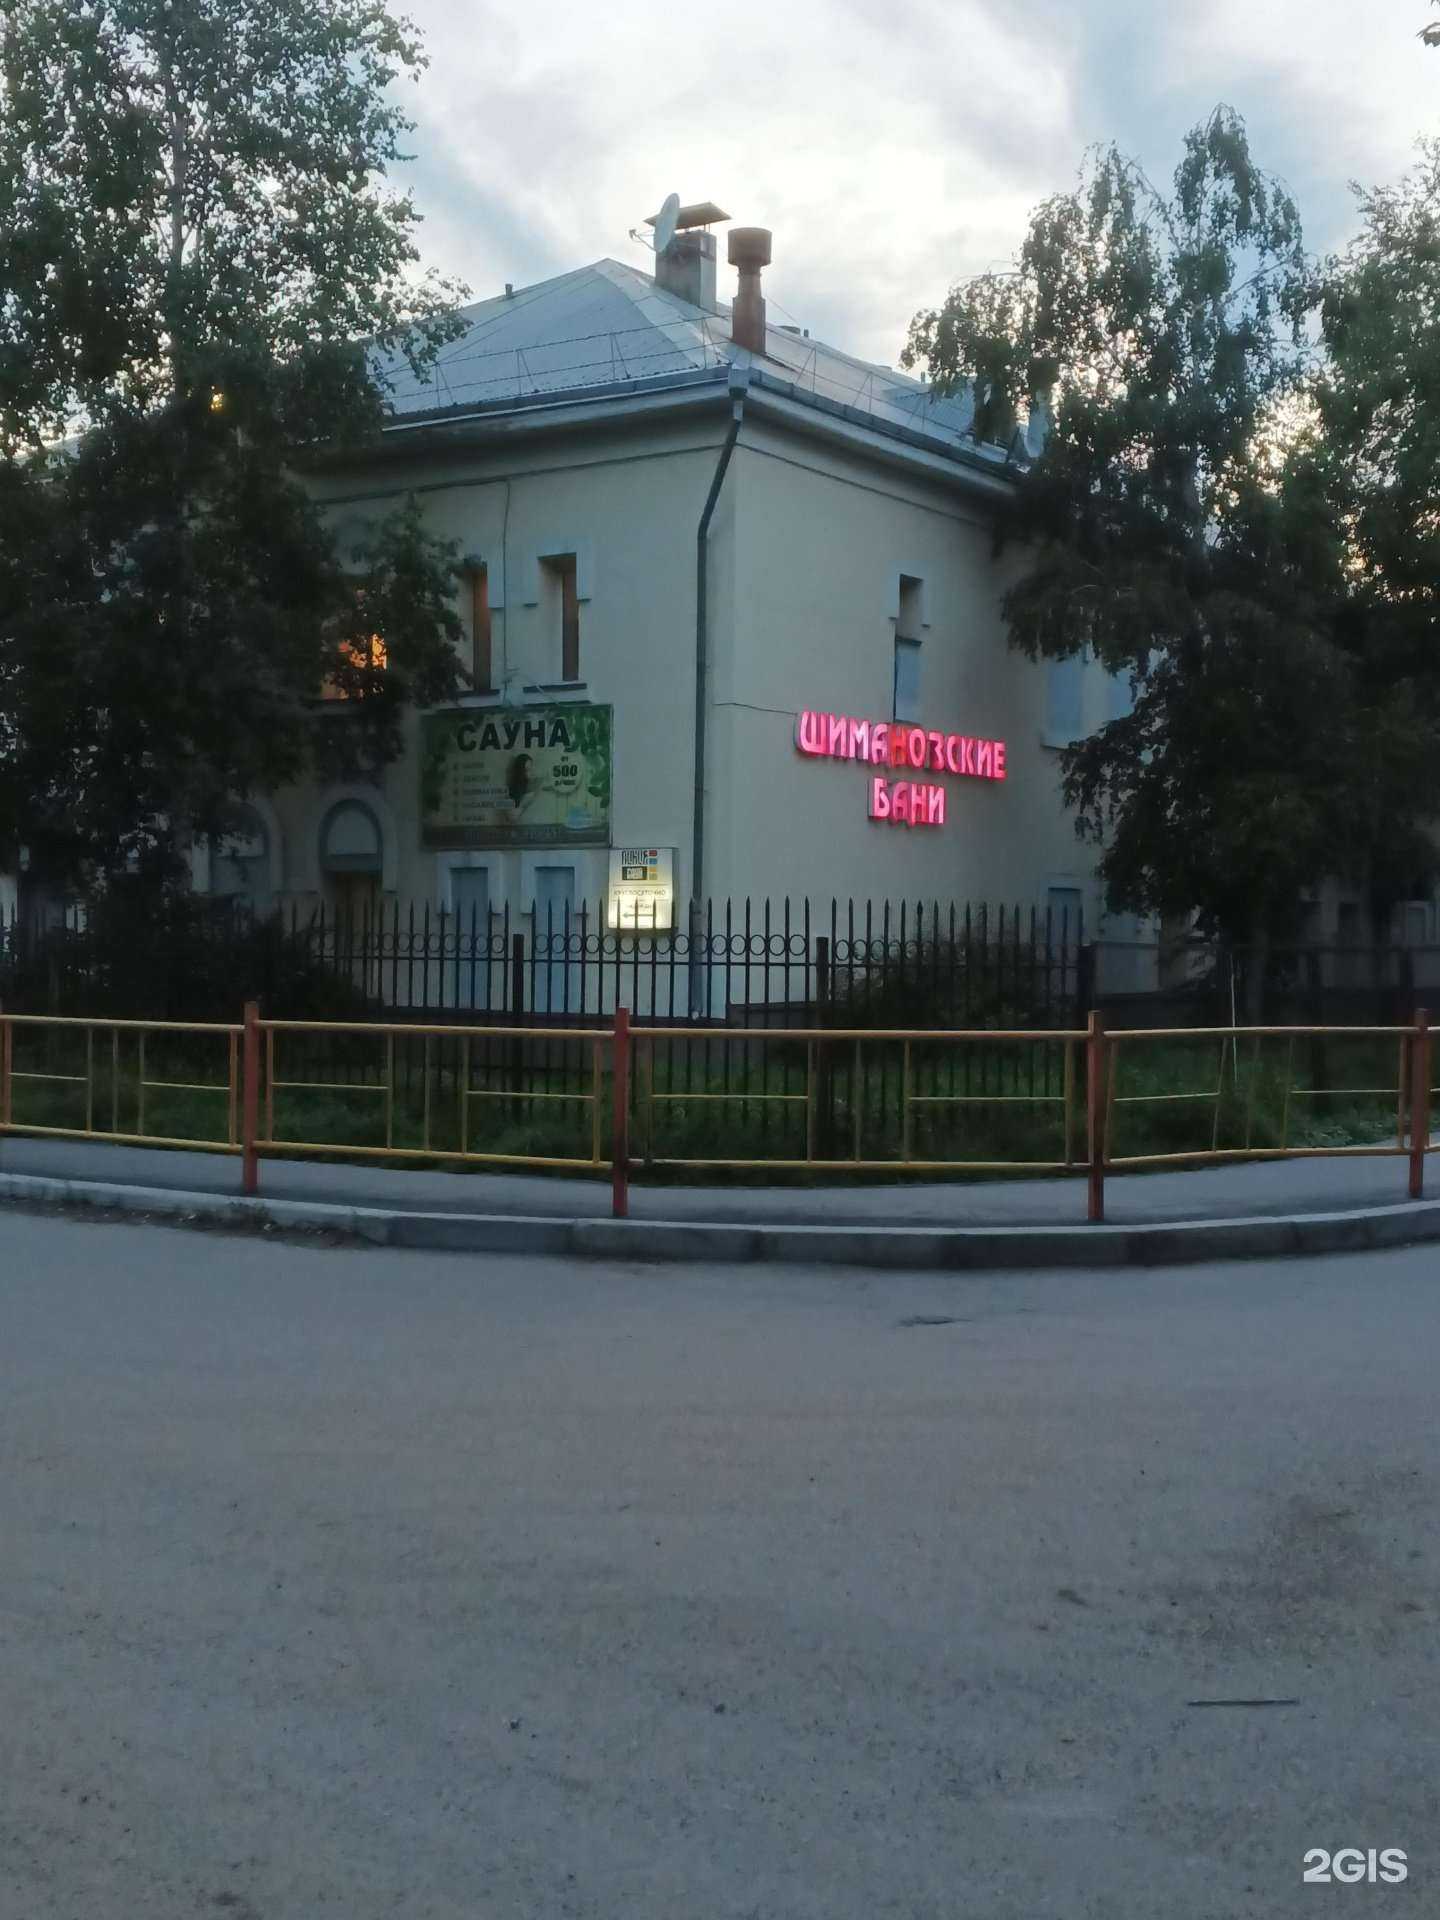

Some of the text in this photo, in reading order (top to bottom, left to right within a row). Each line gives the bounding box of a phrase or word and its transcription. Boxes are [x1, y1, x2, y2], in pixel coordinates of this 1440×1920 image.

[457, 720, 571, 751] САУНА
[552, 764, 578, 777] 500
[872, 778, 945, 825] БАНИ
